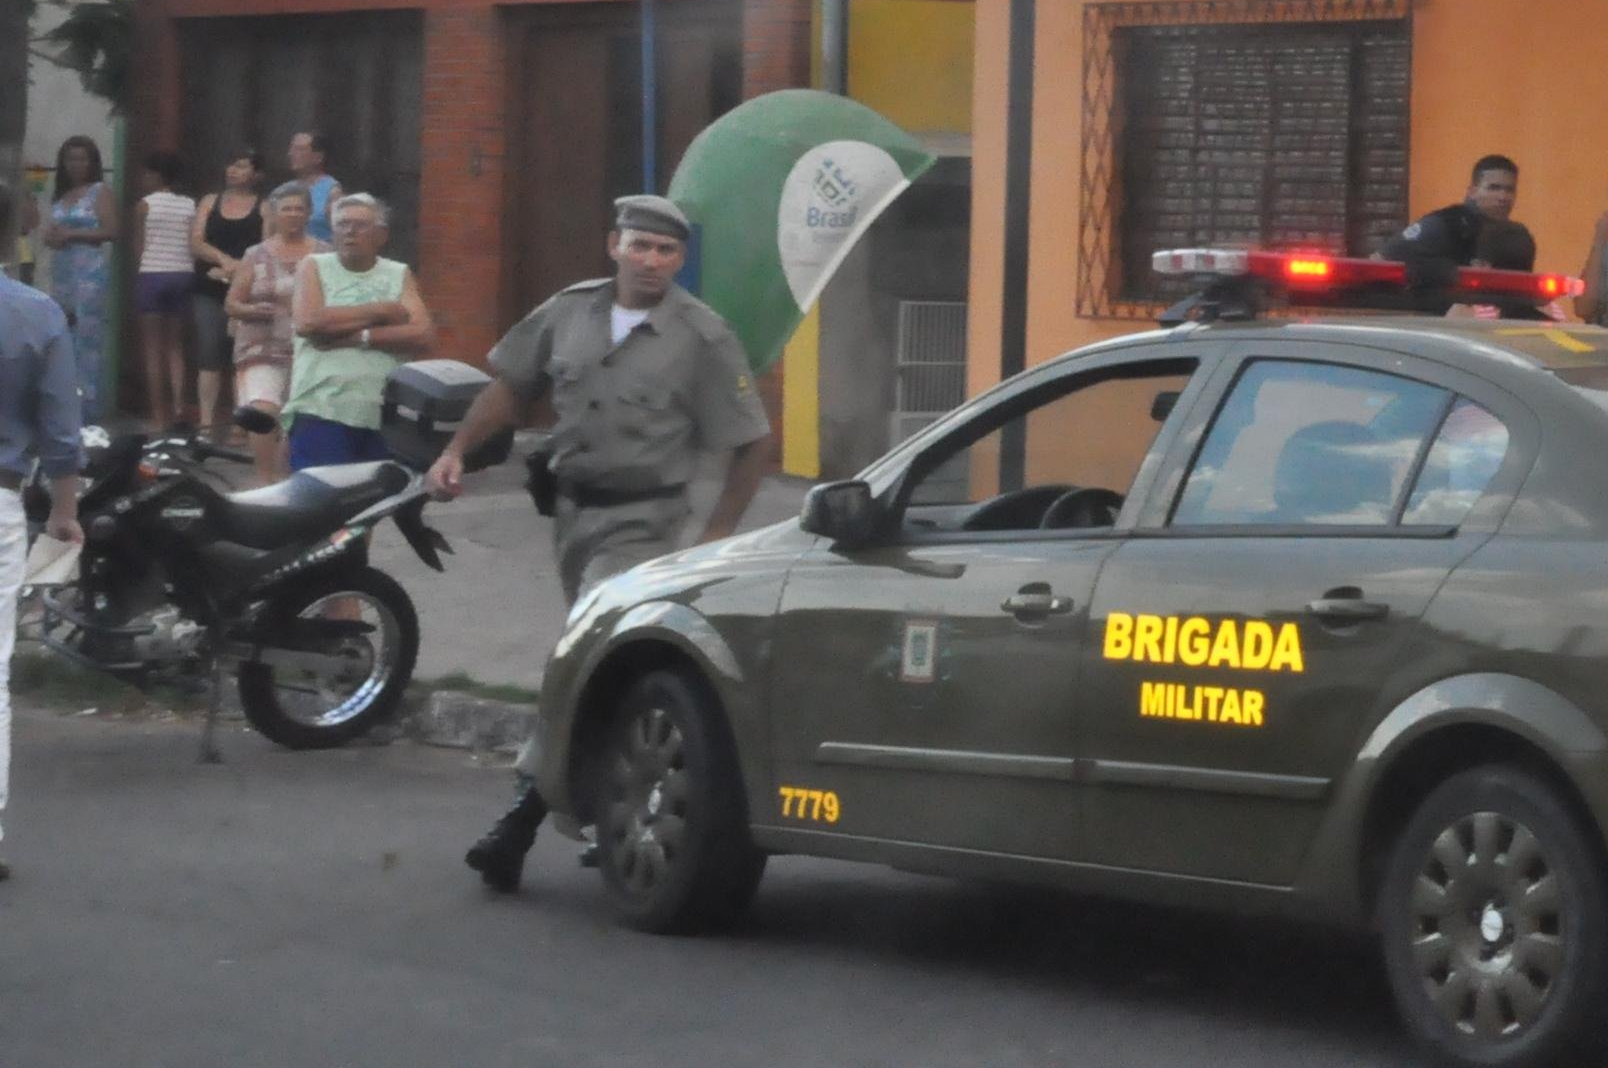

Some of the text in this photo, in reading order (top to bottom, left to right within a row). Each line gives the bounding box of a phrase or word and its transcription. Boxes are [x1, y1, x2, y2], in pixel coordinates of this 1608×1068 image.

[1103, 612, 1304, 672] BRIGADA
[1140, 681, 1264, 726] MILITAR
[779, 787, 840, 823] 7779
